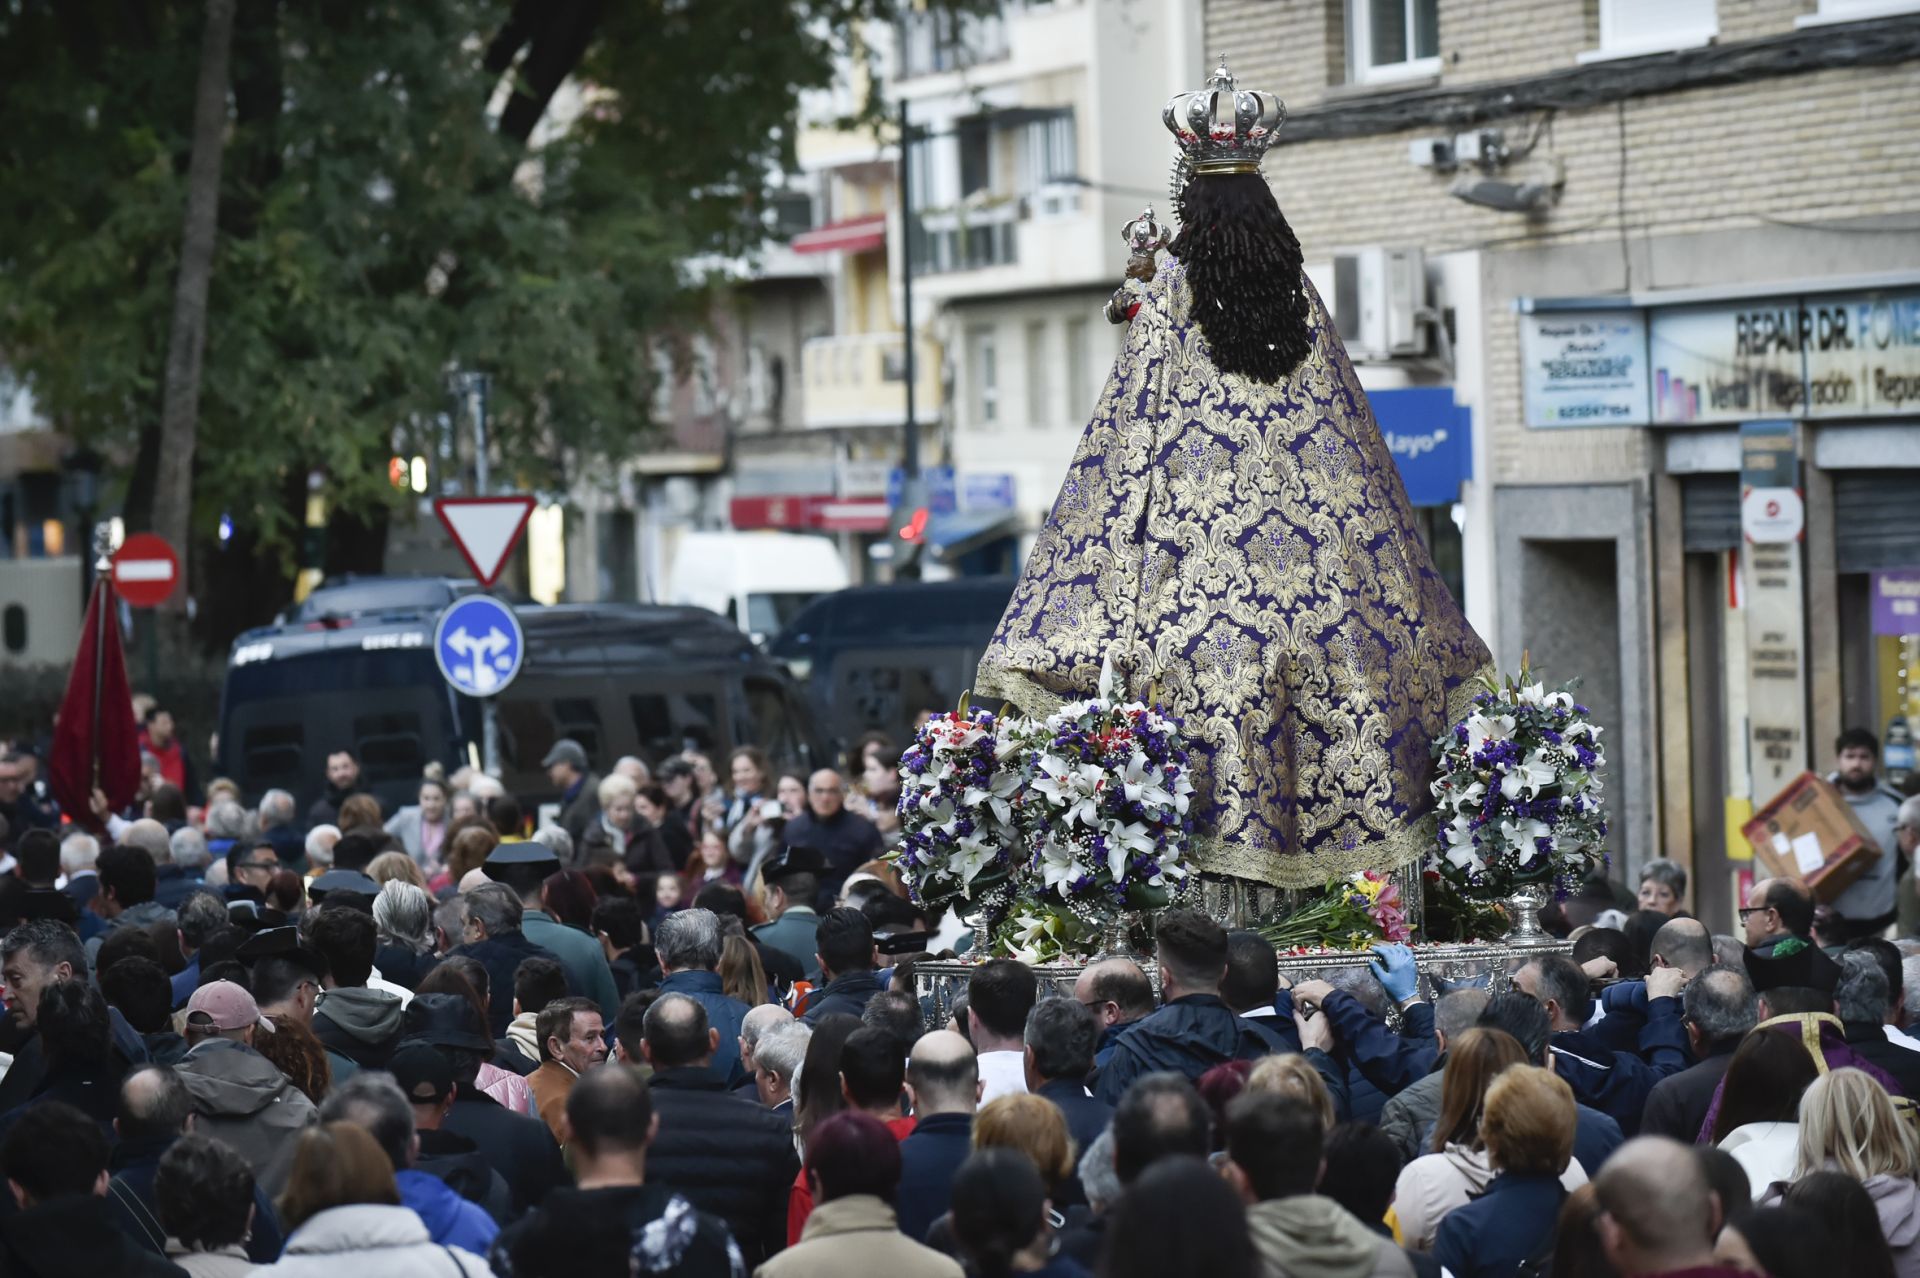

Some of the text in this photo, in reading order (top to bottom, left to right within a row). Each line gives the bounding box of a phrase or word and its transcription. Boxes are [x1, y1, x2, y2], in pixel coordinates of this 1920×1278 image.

[1737, 307, 1814, 357] REPAIR
[1818, 306, 1855, 351] DR.
[1386, 431, 1436, 459] layo
